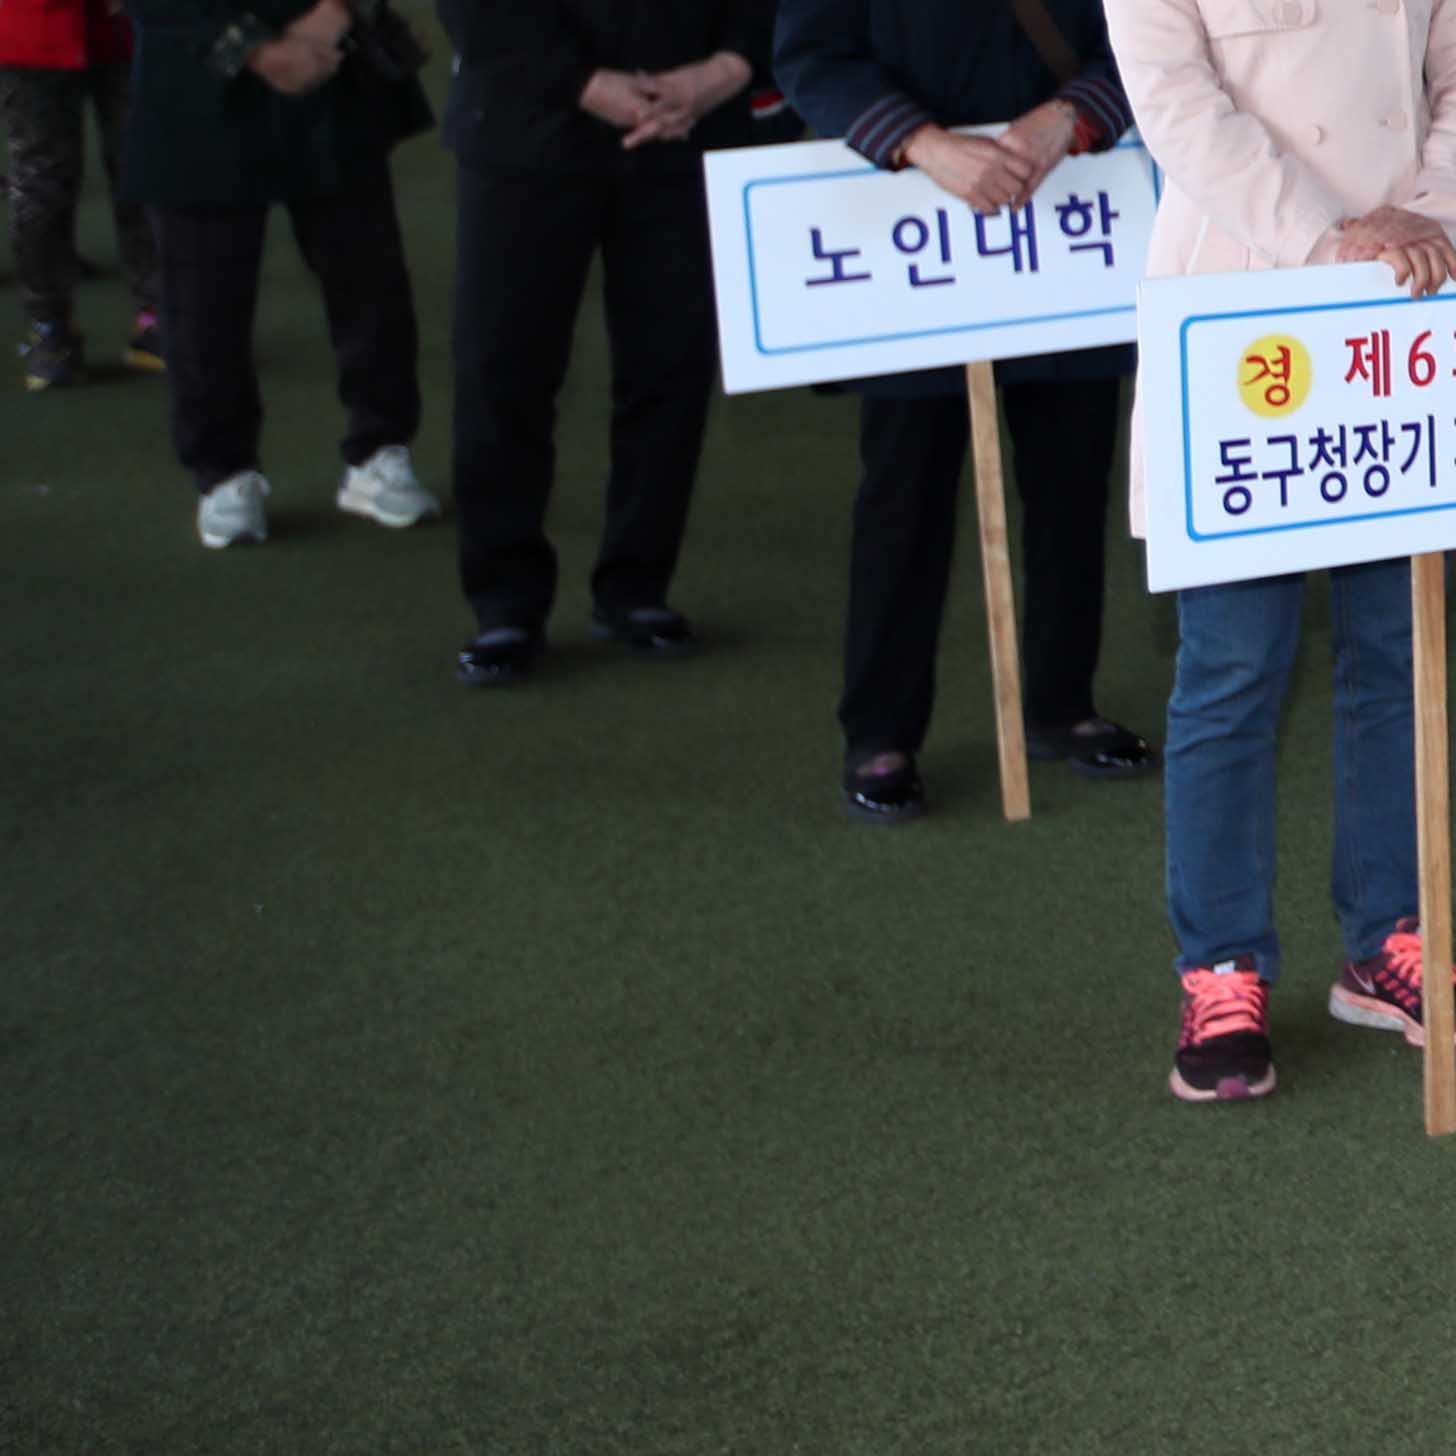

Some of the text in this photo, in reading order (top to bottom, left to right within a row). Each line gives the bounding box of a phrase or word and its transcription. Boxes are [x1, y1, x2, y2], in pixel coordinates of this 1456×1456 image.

[804, 191, 1120, 288] 노인대학
[1242, 344, 1293, 407] 경
[1214, 414, 1438, 516] 동구청장기
